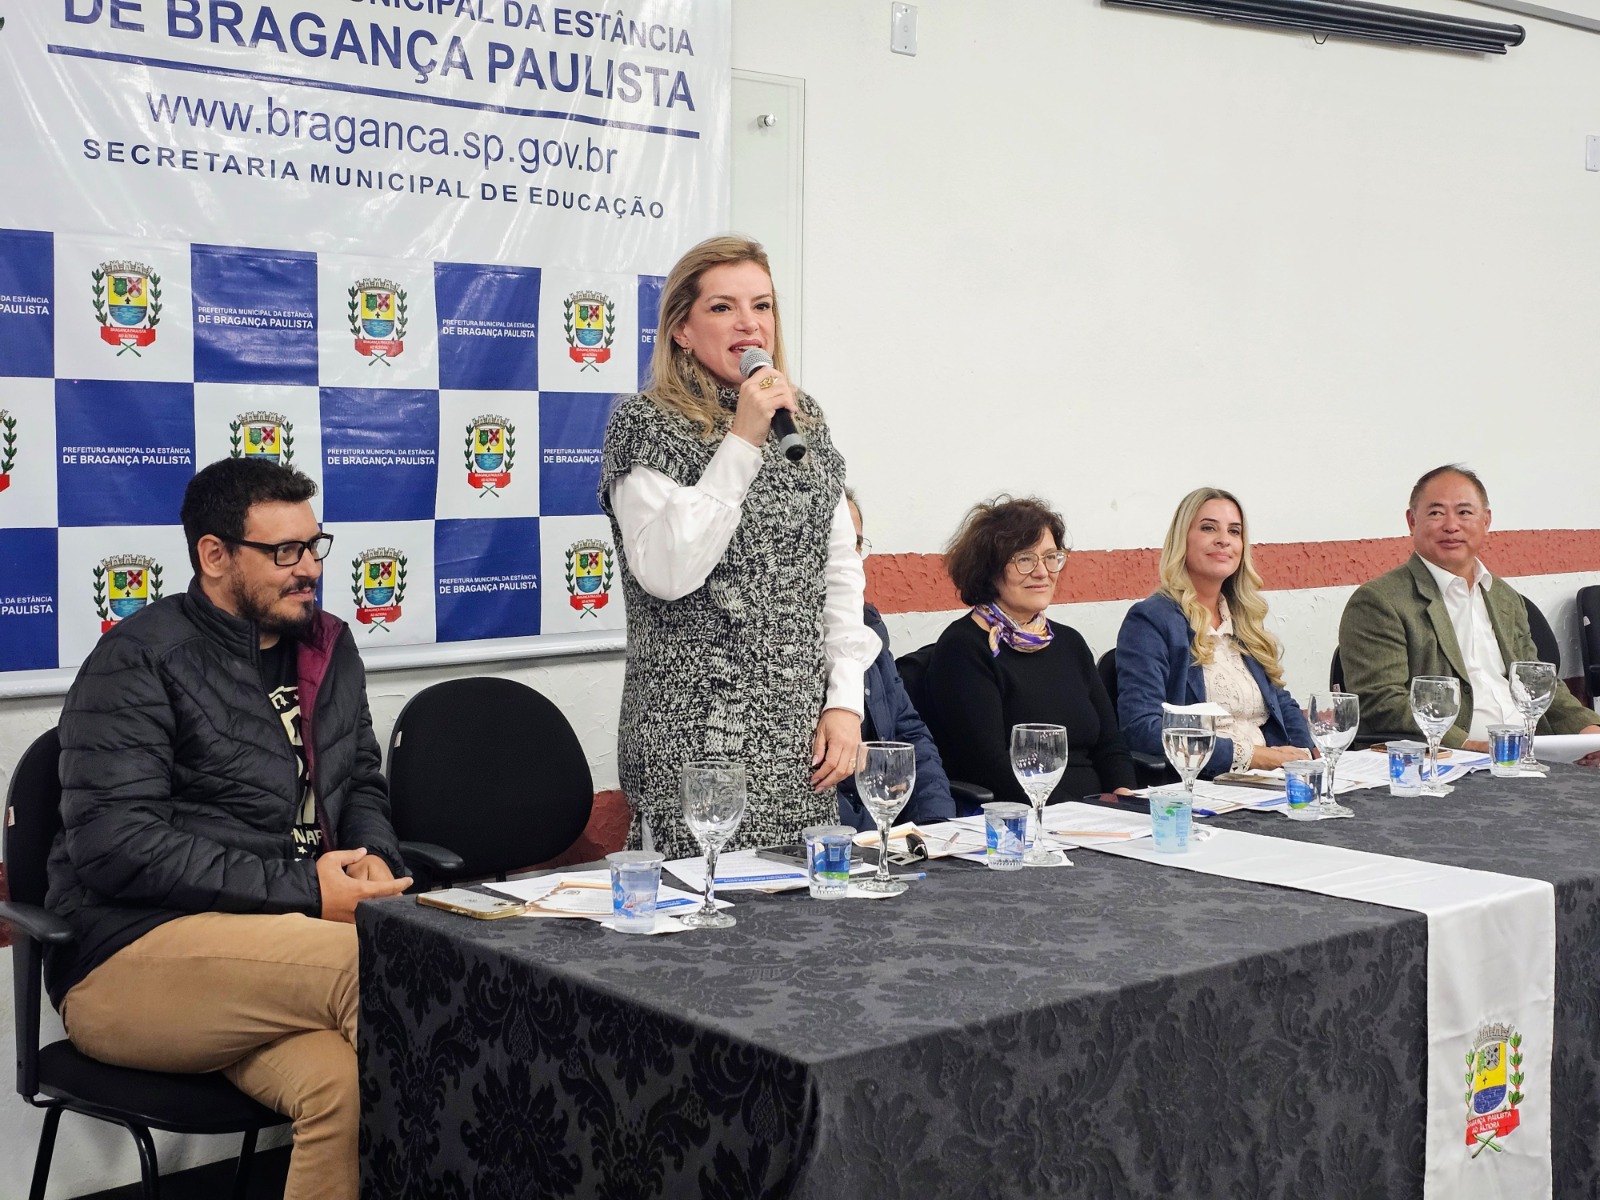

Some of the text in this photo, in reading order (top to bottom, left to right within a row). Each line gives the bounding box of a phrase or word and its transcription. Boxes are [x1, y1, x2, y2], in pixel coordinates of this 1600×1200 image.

[503, 0, 546, 32] DA
[554, 9, 694, 57] ESTÂNCIA
[64, 0, 696, 112] DE BRAGANÇA PAULISTA
[146, 91, 618, 175] www.braganca.sp.gov.br
[83, 138, 665, 220] SECRETARIA MUNICIPAL DE EDUCAÇÃO
[12, 295, 49, 304] ESTÂNCIA
[198, 306, 314, 319] PREFEITURA MUNICIPAL DA ESTÂNCIA
[198, 314, 314, 329] DE BRAGANÇA PAULISTA
[442, 326, 535, 338] DE BRAGANÇA PAULISTA
[641, 335, 652, 343] DE
[62, 446, 106, 454] PREFEITURA
[107, 446, 144, 454] MUNICIPAL
[157, 446, 191, 454] ESTÂNCIA
[407, 447, 436, 455] ESTÂNCIA
[62, 455, 192, 467] DE BRAGANÇA PAULISTA
[327, 456, 436, 467] DE BRAGANÇA PAULISTA
[543, 455, 554, 464] DE
[555, 455, 599, 465] BRAGANÇA
[439, 573, 537, 585] PREFEITURA MUNICIPAL DA ESTÂNCIA
[439, 581, 538, 595] DE BRAGANÇA PAULISTA
[16, 595, 53, 603] ESTÂNCIA
[1, 604, 54, 615] PAULISTA
